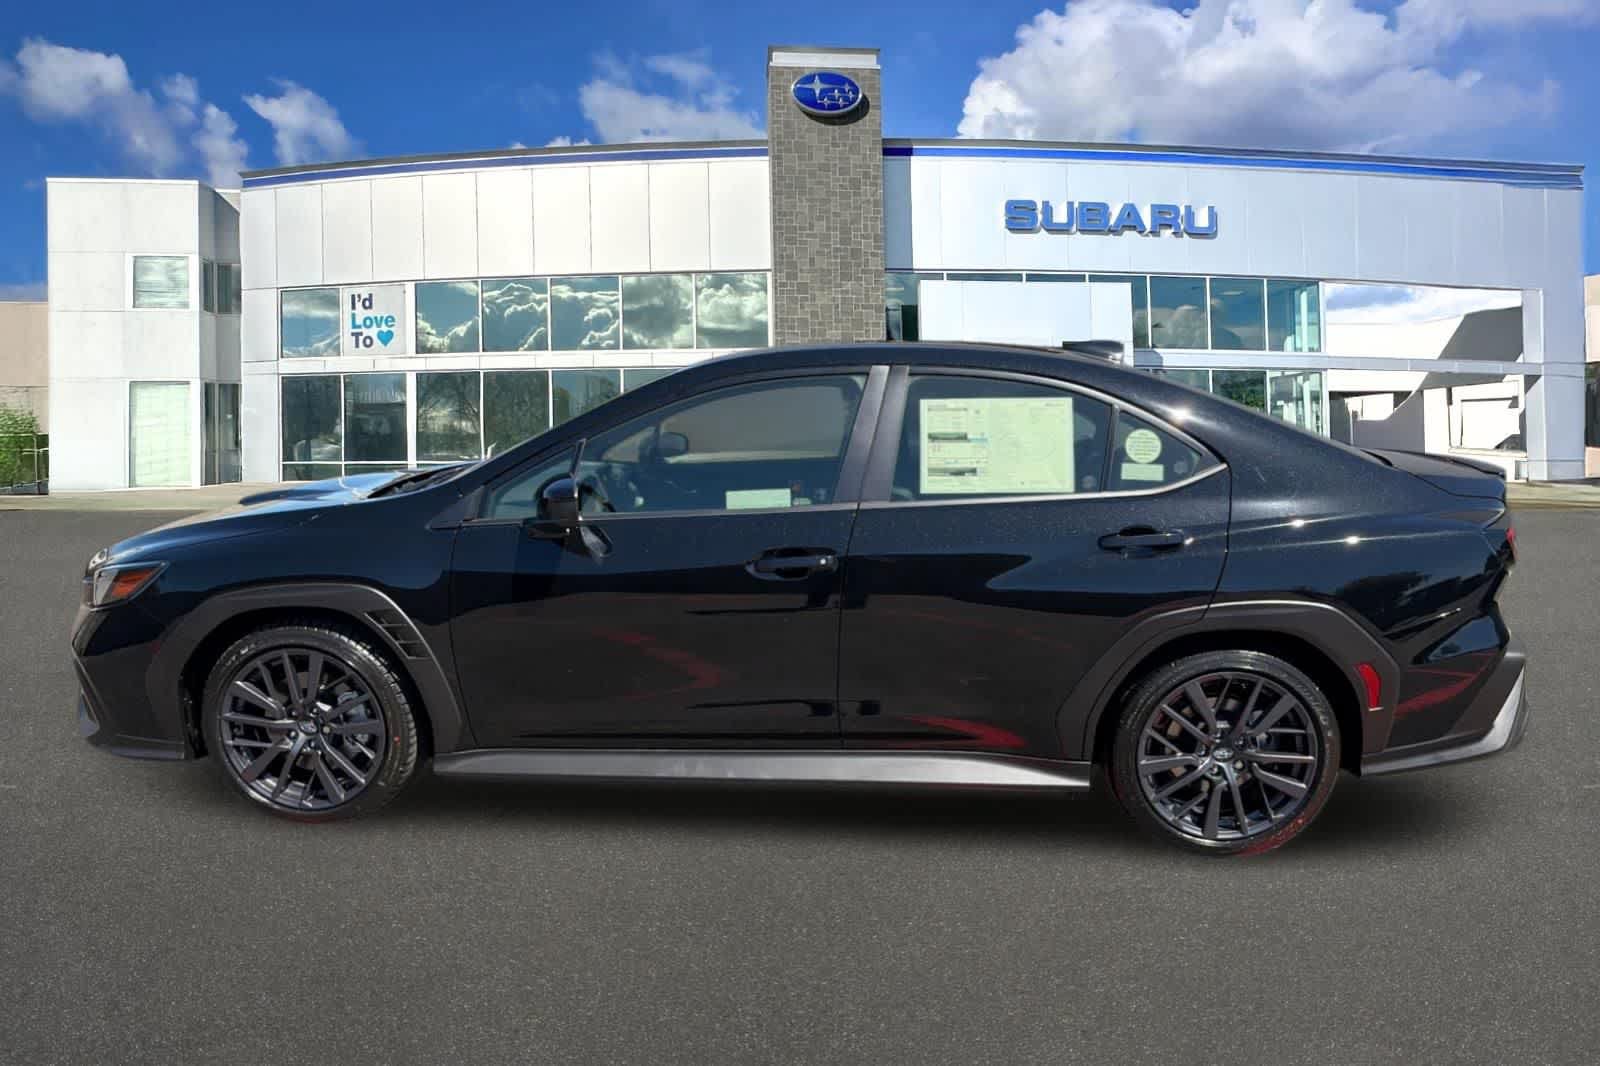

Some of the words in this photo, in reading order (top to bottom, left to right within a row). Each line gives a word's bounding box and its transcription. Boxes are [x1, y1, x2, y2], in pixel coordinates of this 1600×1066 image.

[1005, 199, 1217, 237] SUBARU
[351, 293, 373, 310] I'd
[351, 312, 396, 329] Love
[351, 331, 374, 348] To
